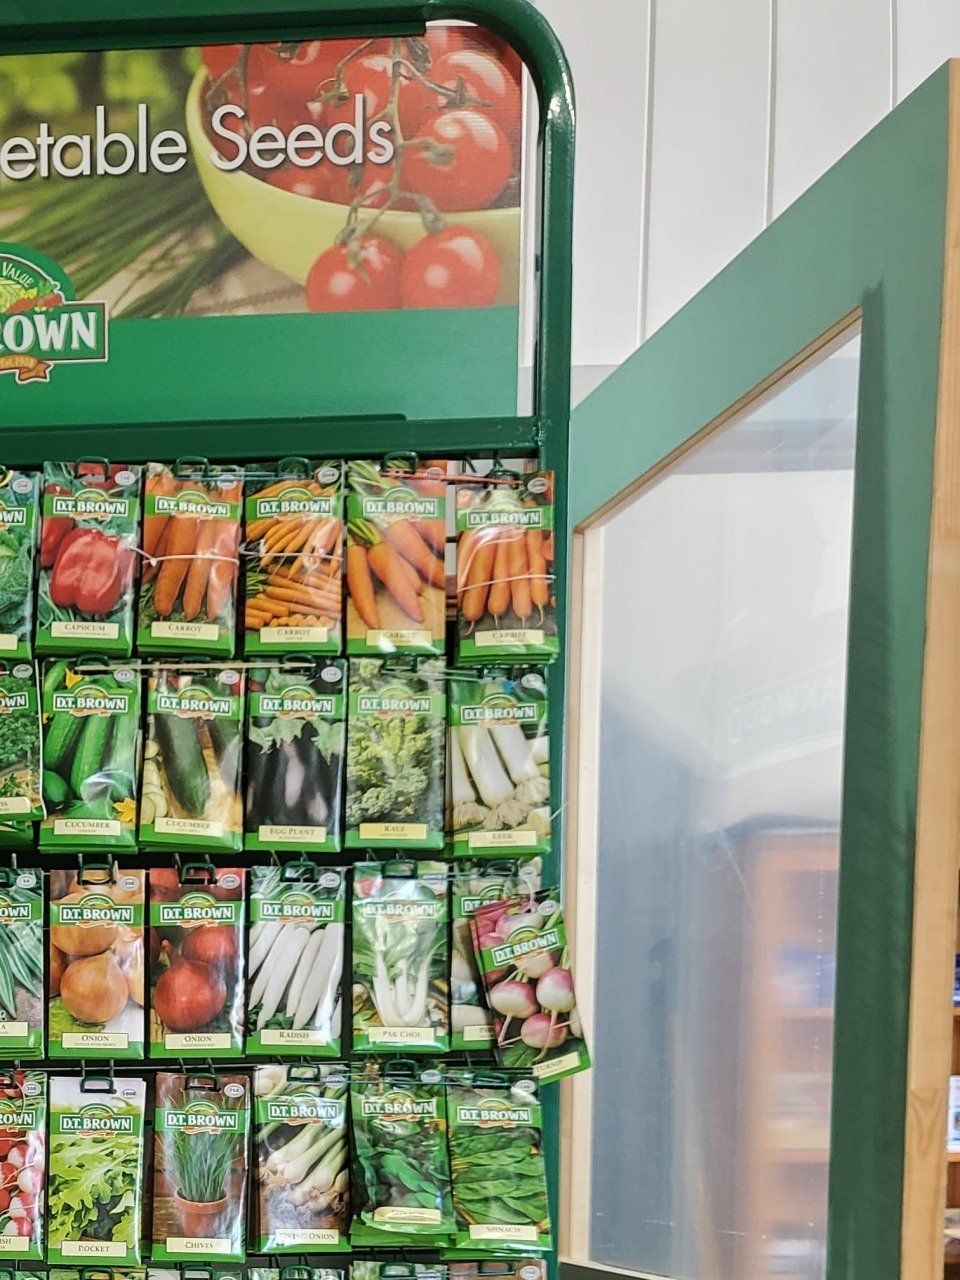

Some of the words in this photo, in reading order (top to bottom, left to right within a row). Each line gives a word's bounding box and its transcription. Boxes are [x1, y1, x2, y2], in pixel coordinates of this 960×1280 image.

[210, 94, 394, 171] Seeds
[81, 1034, 109, 1042] ONION
[82, 1118, 131, 1129] BROWN
[185, 1241, 214, 1249] CHIVES
